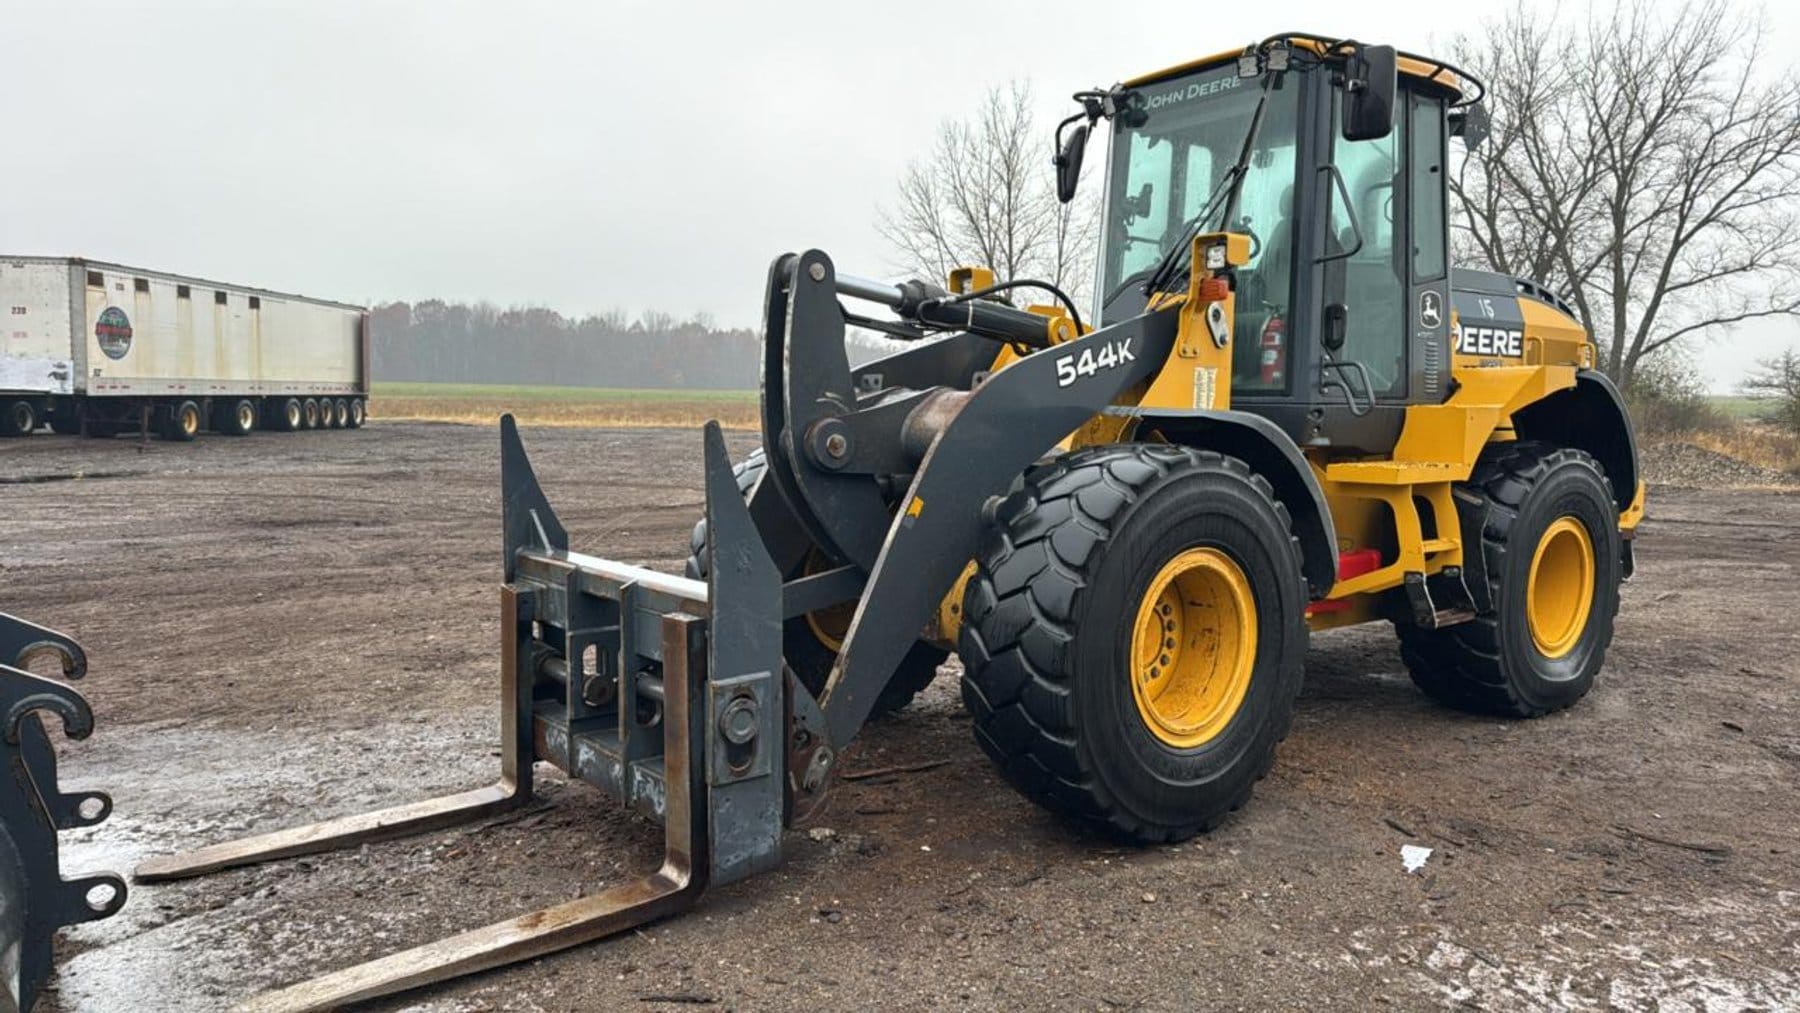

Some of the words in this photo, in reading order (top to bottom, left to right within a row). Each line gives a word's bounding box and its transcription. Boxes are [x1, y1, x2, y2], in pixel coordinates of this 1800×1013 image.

[1143, 89, 1184, 111] JOHN
[1187, 75, 1241, 99] DEERE
[1478, 298, 1495, 320] 15
[1056, 337, 1136, 387] 544K
